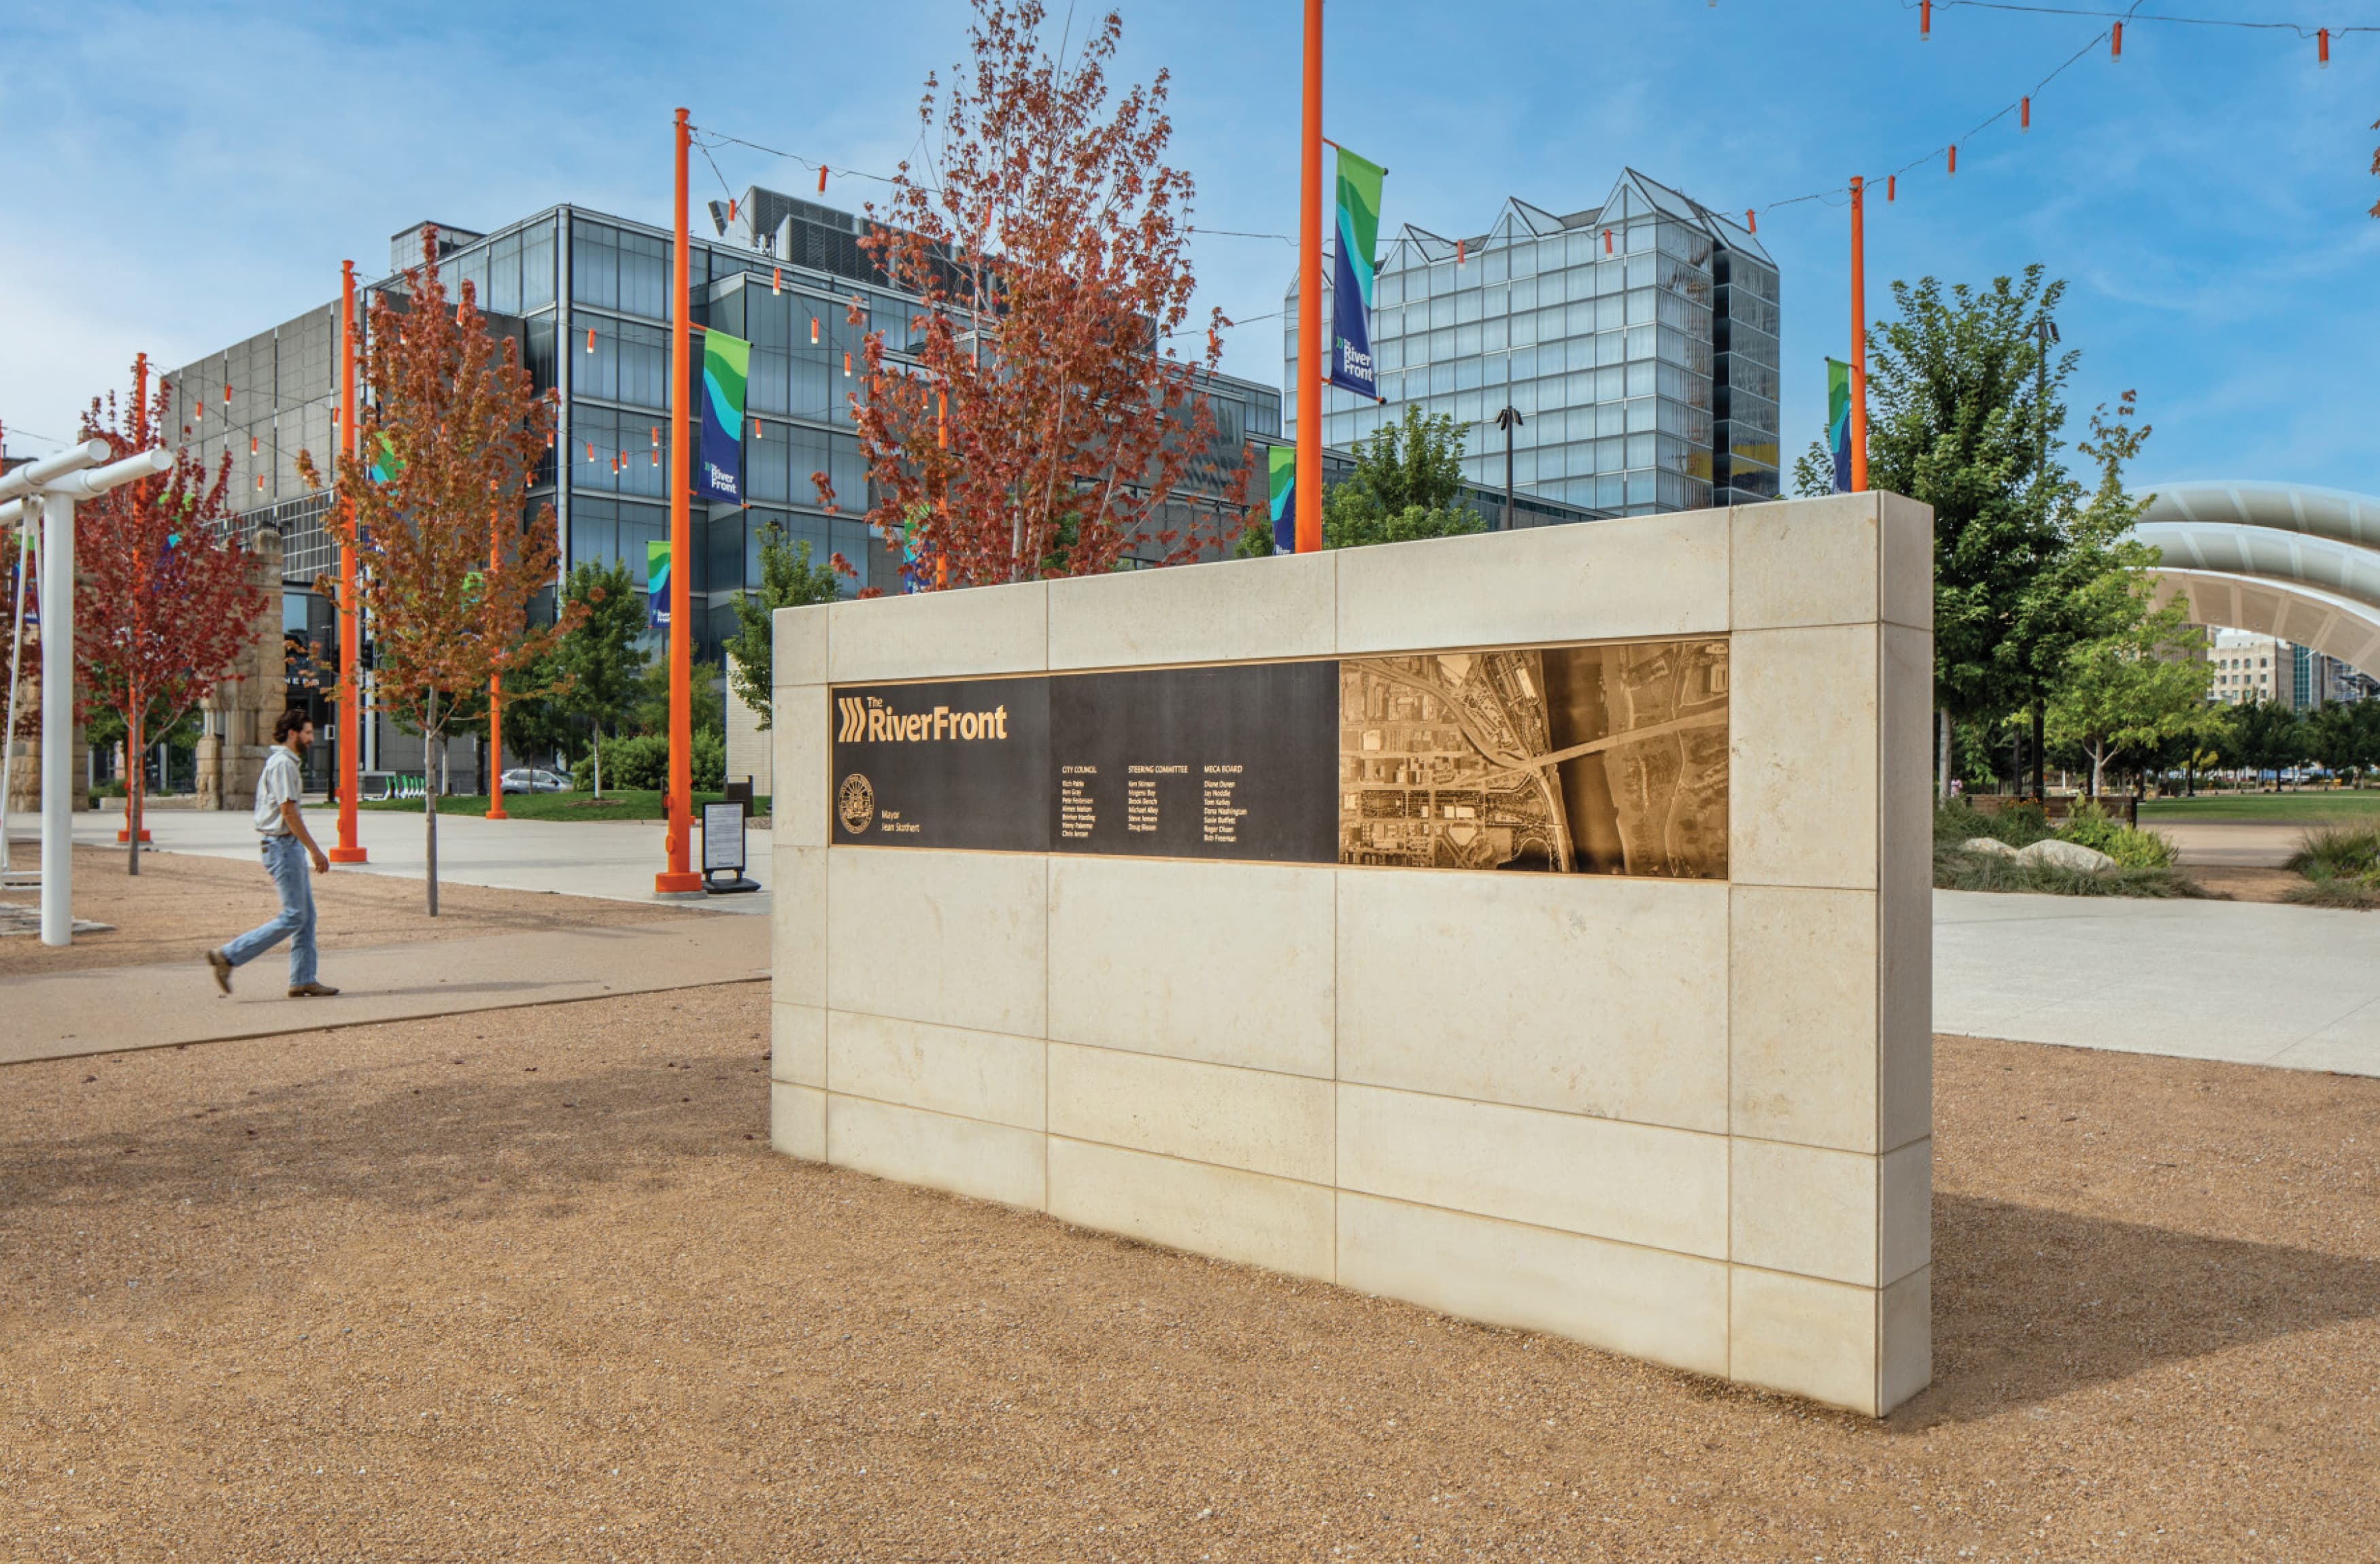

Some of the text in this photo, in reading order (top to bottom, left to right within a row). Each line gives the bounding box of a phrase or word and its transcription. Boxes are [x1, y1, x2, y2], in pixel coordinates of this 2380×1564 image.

[1344, 345, 1371, 367] River
[1344, 359, 1373, 382] Front
[711, 467, 734, 483] River
[711, 477, 736, 494] Front
[866, 696, 883, 707] The
[868, 704, 1008, 742] RiverFront
[1128, 765, 1188, 773] STEERING COMMITTEE
[1221, 765, 1243, 773] BOARD
[881, 810, 900, 821] Mayor
[881, 822, 895, 832] Jean
